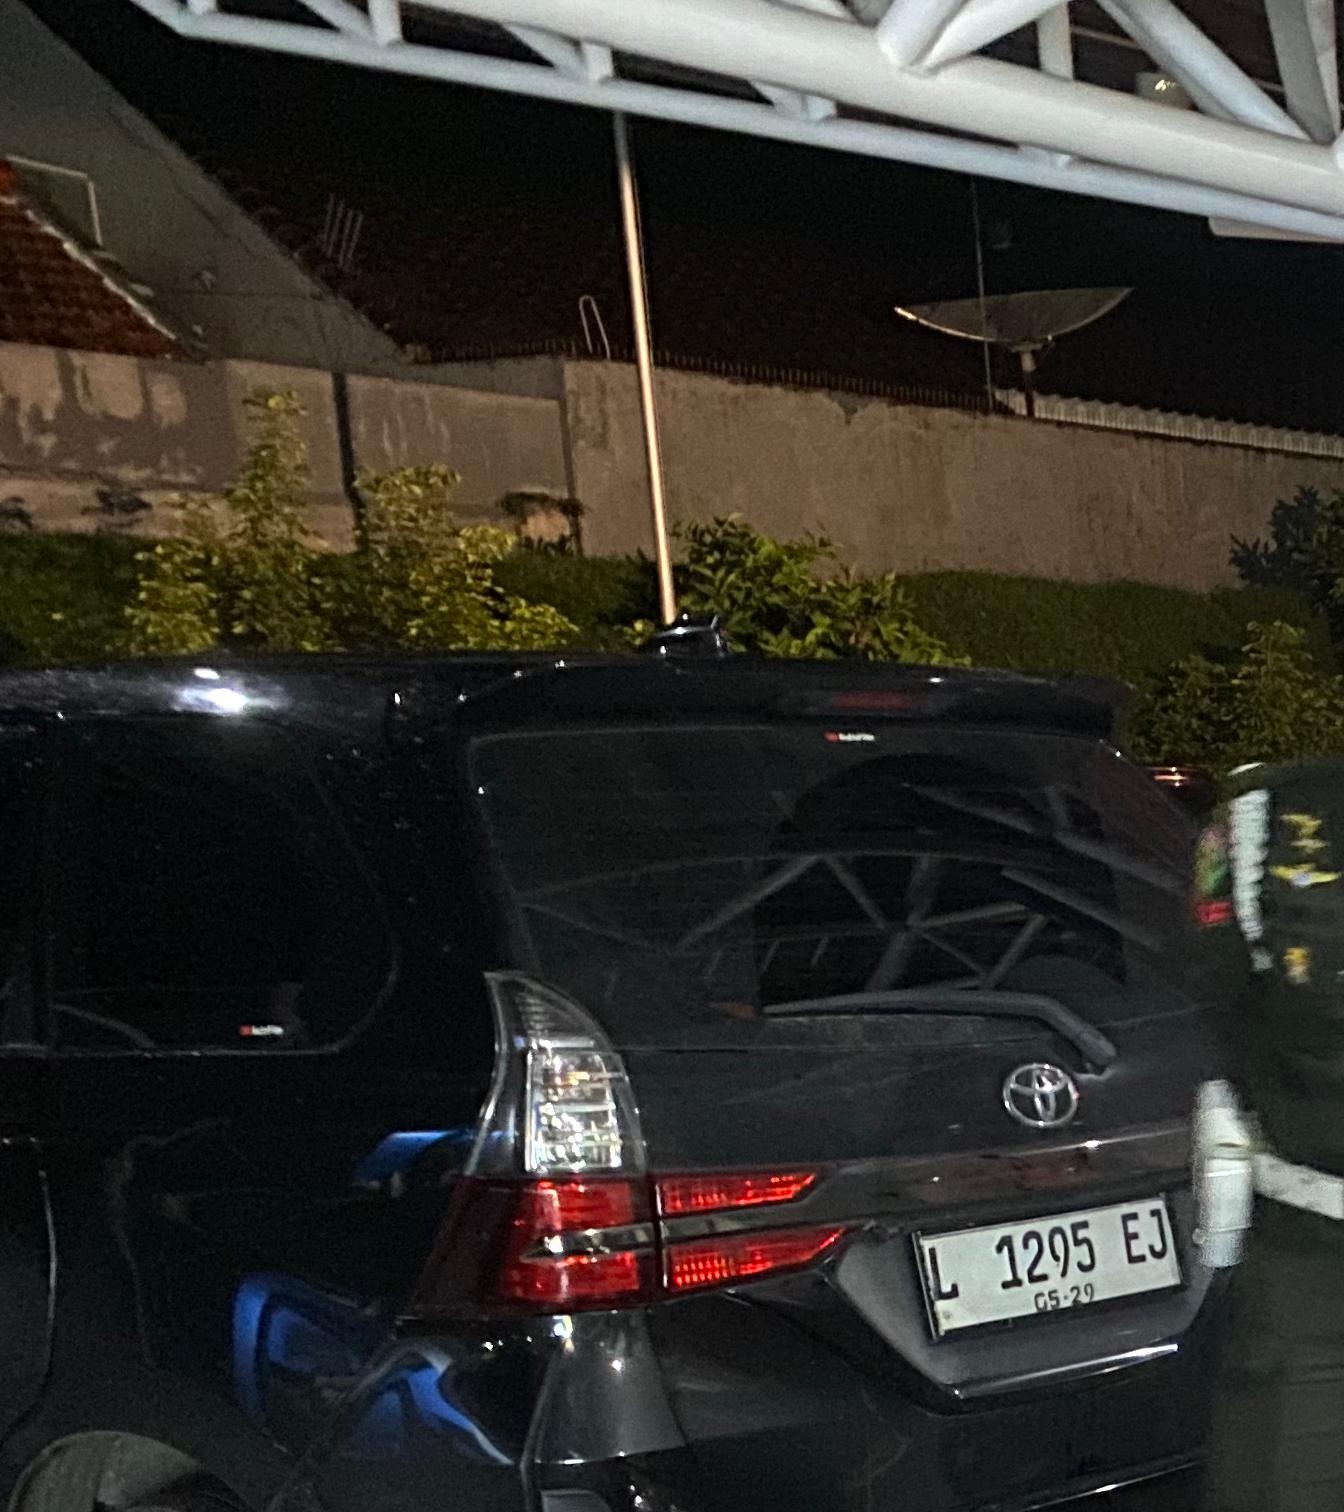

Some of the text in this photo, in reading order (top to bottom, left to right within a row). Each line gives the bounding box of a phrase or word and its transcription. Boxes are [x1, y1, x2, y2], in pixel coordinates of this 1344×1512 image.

[929, 1208, 1168, 1300] L 1295 EJ
